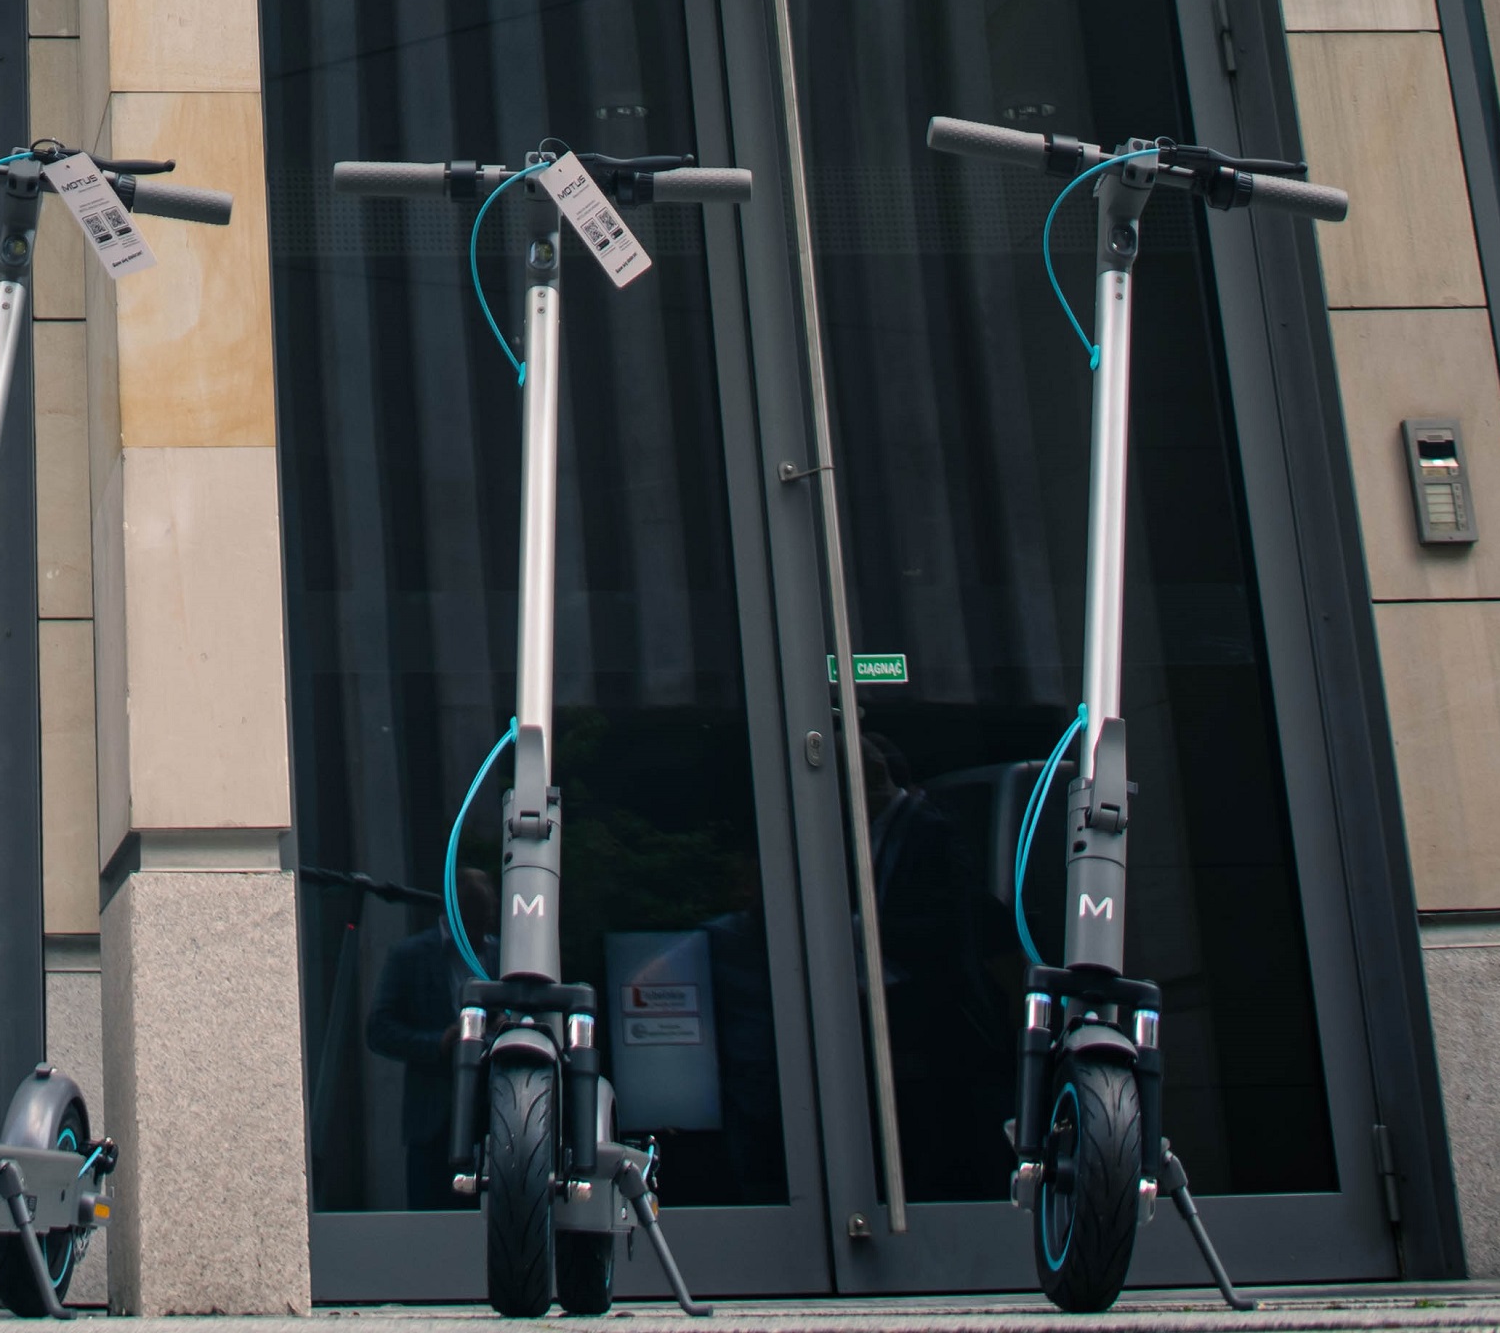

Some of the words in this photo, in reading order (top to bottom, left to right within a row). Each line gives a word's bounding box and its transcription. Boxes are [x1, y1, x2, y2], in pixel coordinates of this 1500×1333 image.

[61, 174, 98, 193] MOTUS
[557, 175, 586, 200] MOTUS
[857, 660, 902, 677] CIĄGNĄĆ
[513, 894, 544, 917] M
[1079, 894, 1112, 919] M
